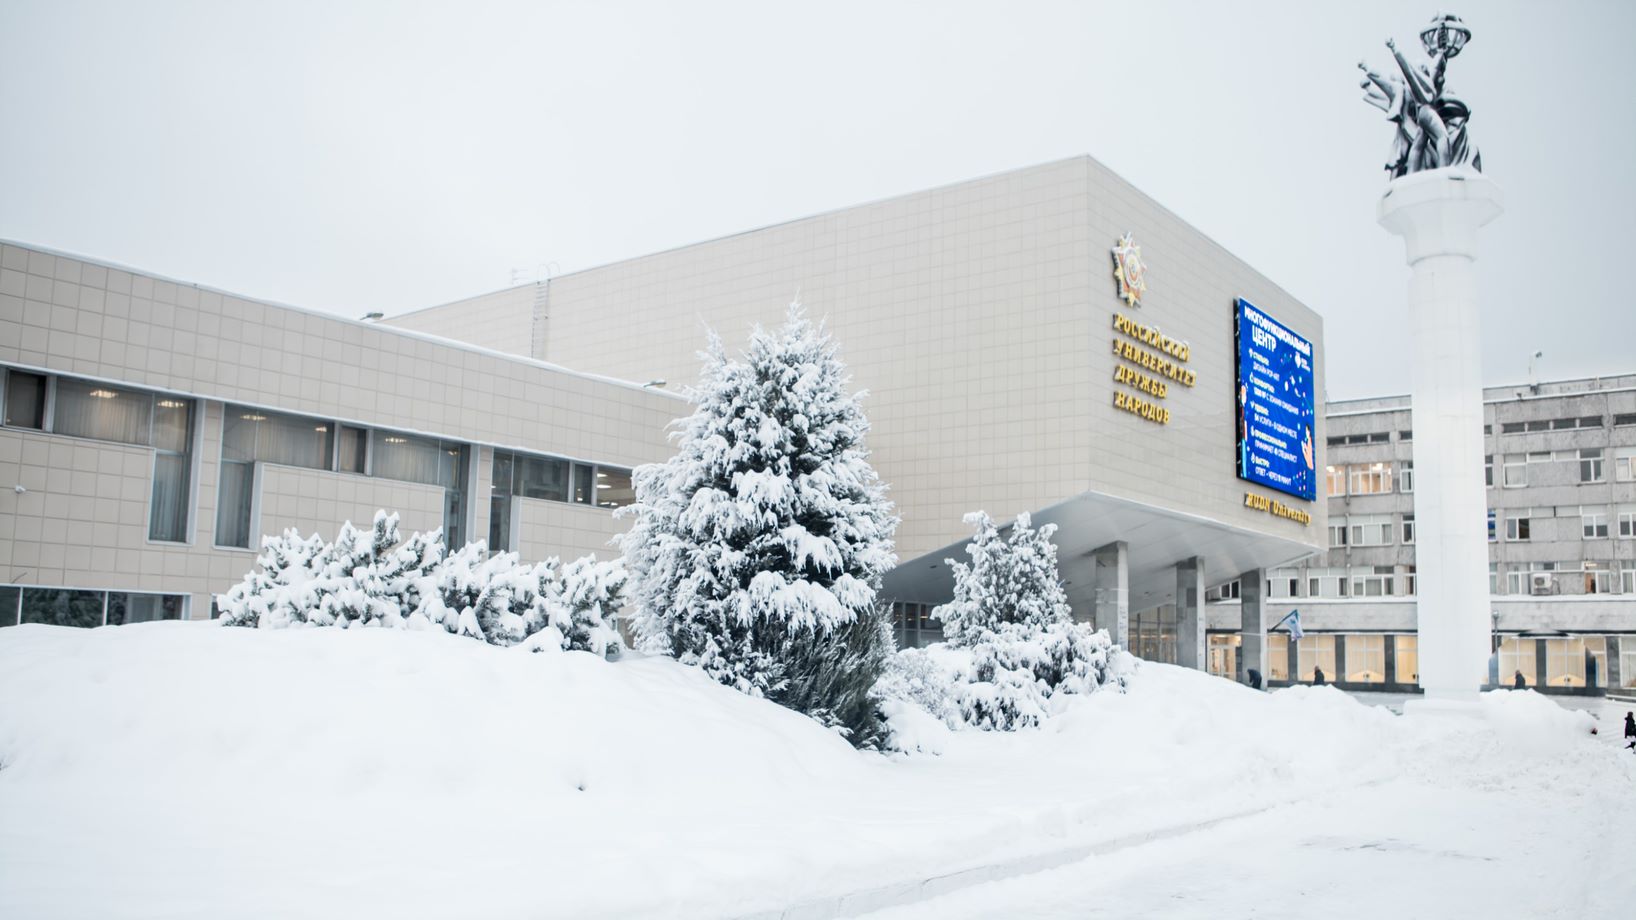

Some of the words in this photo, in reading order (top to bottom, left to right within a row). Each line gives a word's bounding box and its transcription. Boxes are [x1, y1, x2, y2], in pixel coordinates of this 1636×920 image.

[1114, 312, 1191, 363] РОССИЙСКИЙ
[1244, 305, 1311, 357] МНОГОФУНКЦИОНАЛЬНЫЙ
[1252, 324, 1277, 352] ЦЕНТР
[1113, 337, 1197, 388] УНИВЕРСИТЕТ
[1114, 364, 1168, 399] ДРУЖБЫ
[1114, 390, 1170, 425] НАРОДОВ
[1245, 491, 1271, 512] RUDN
[1273, 499, 1312, 527] University
